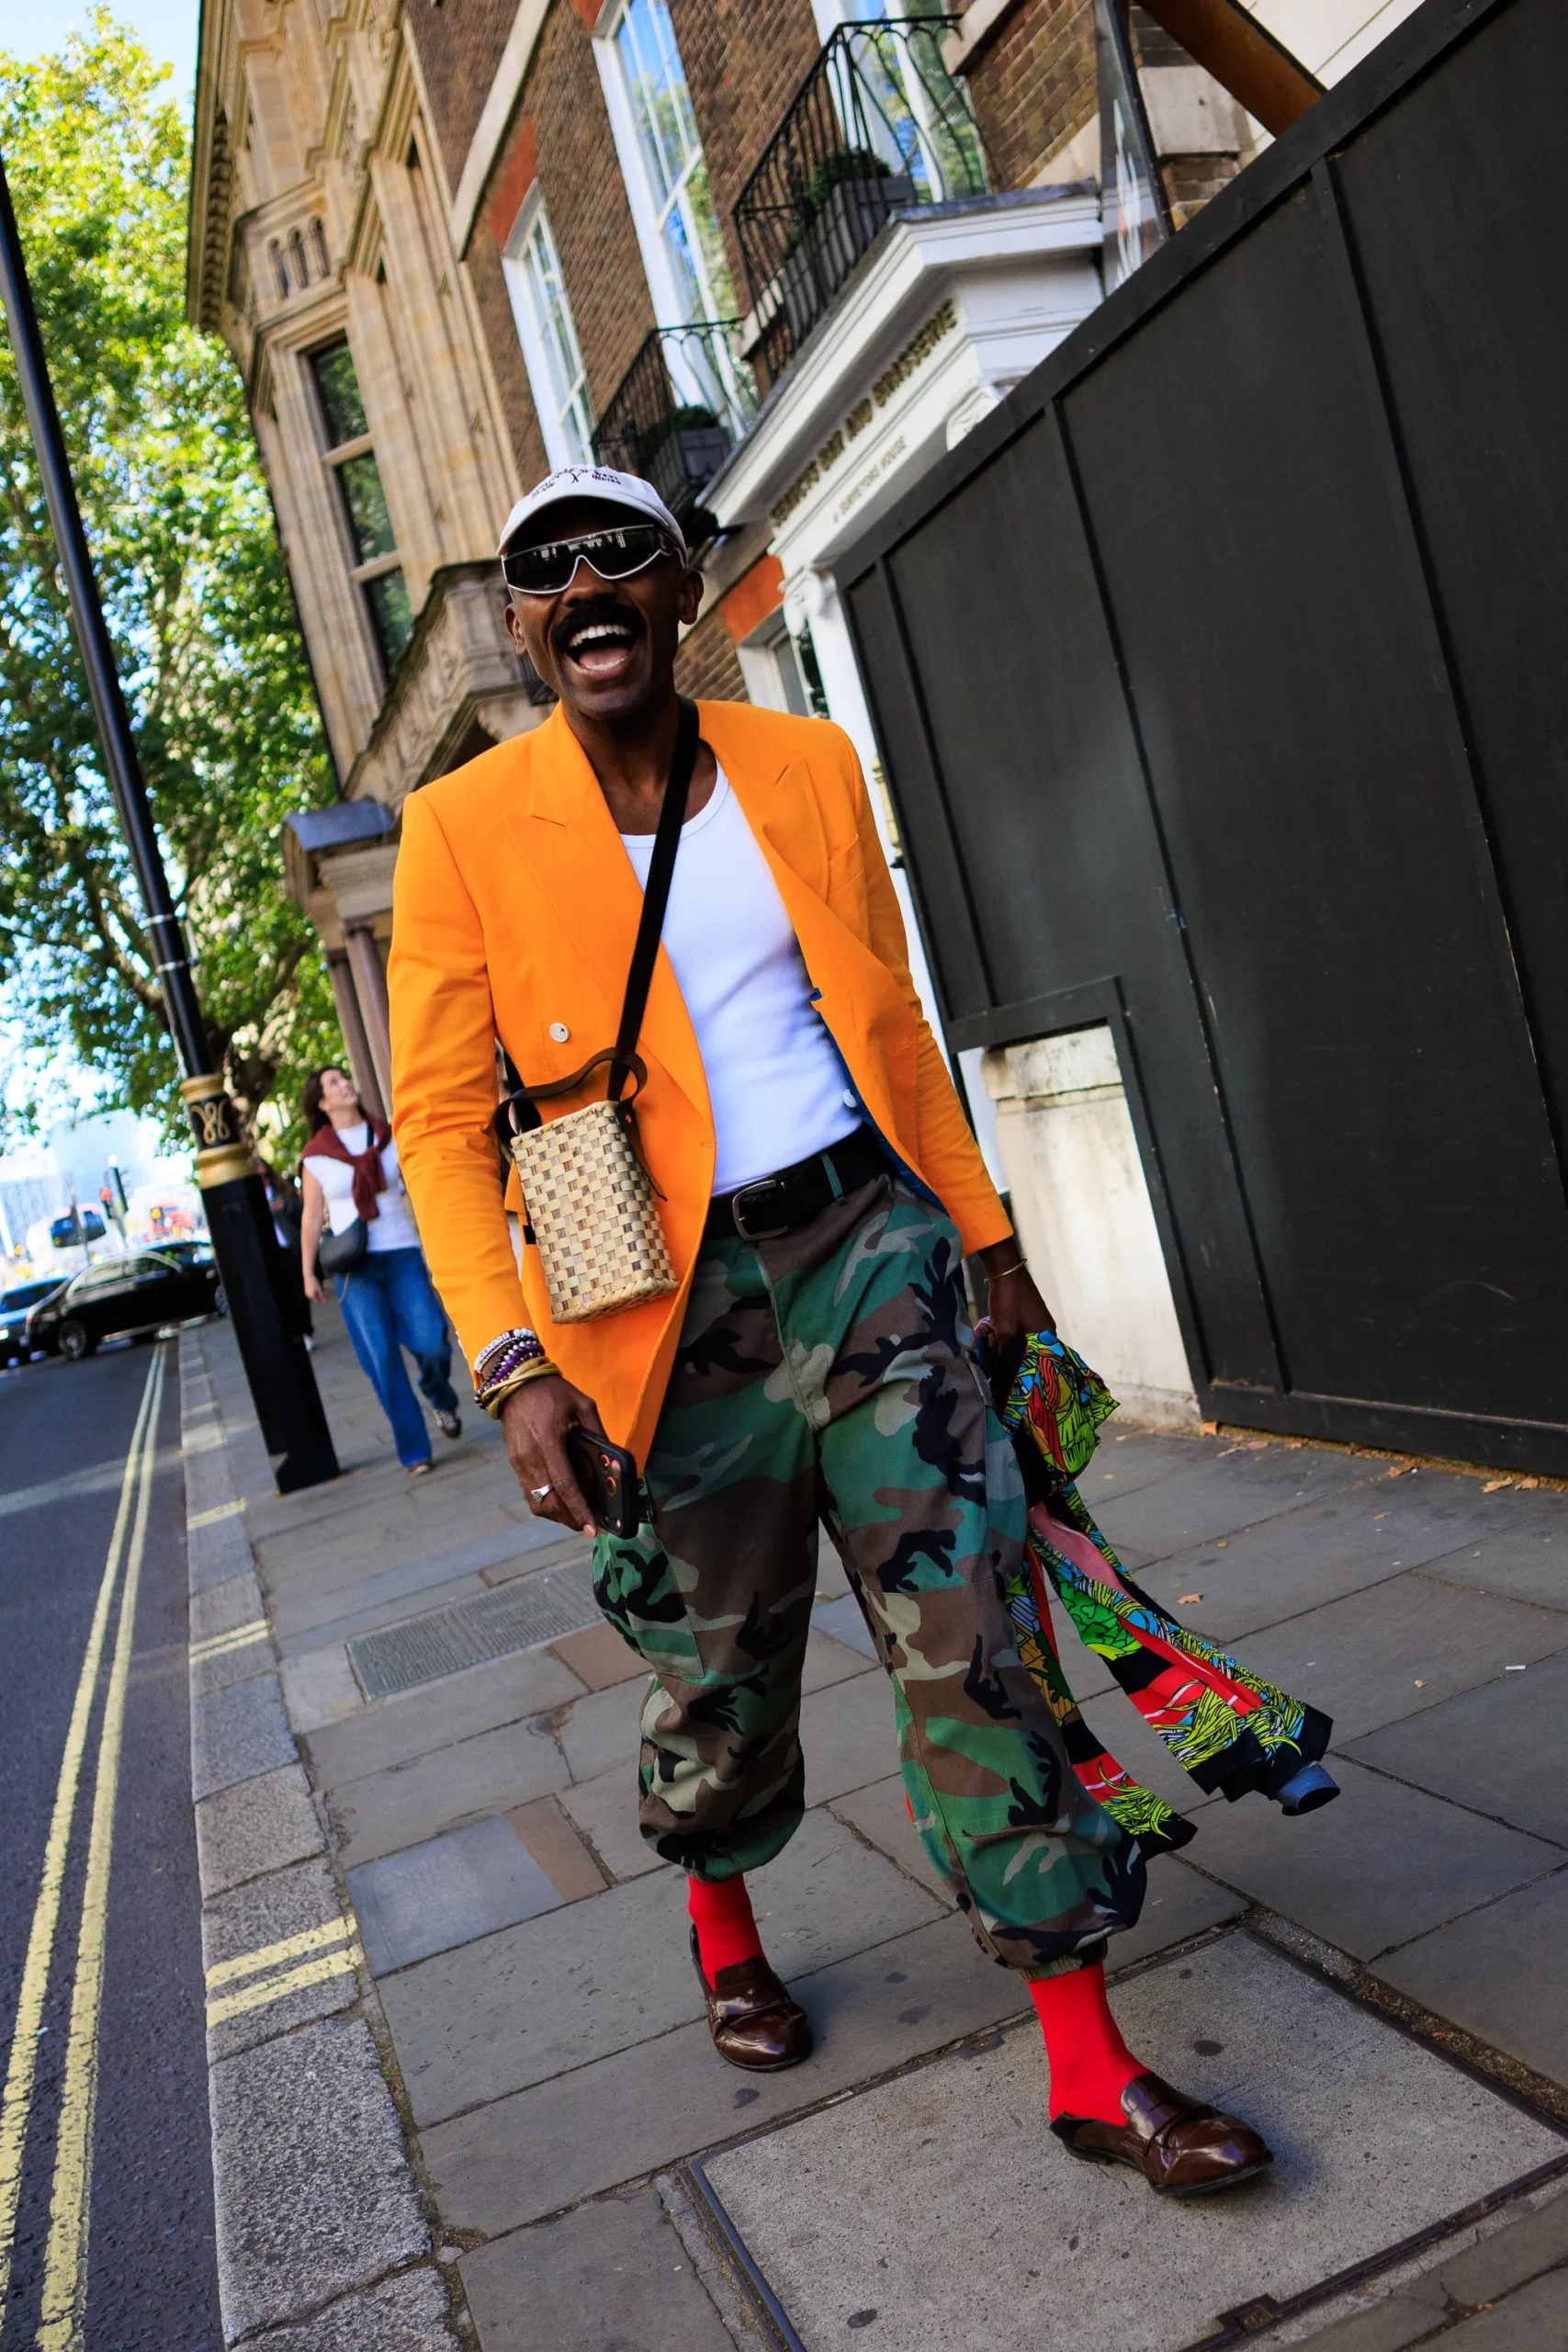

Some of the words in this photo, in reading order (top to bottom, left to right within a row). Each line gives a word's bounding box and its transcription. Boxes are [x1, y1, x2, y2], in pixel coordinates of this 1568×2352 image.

[818, 429, 845, 471] BAR
[845, 397, 873, 442] AND
[871, 298, 957, 408] BRASSERIE
[592, 474, 622, 485] INDIES
